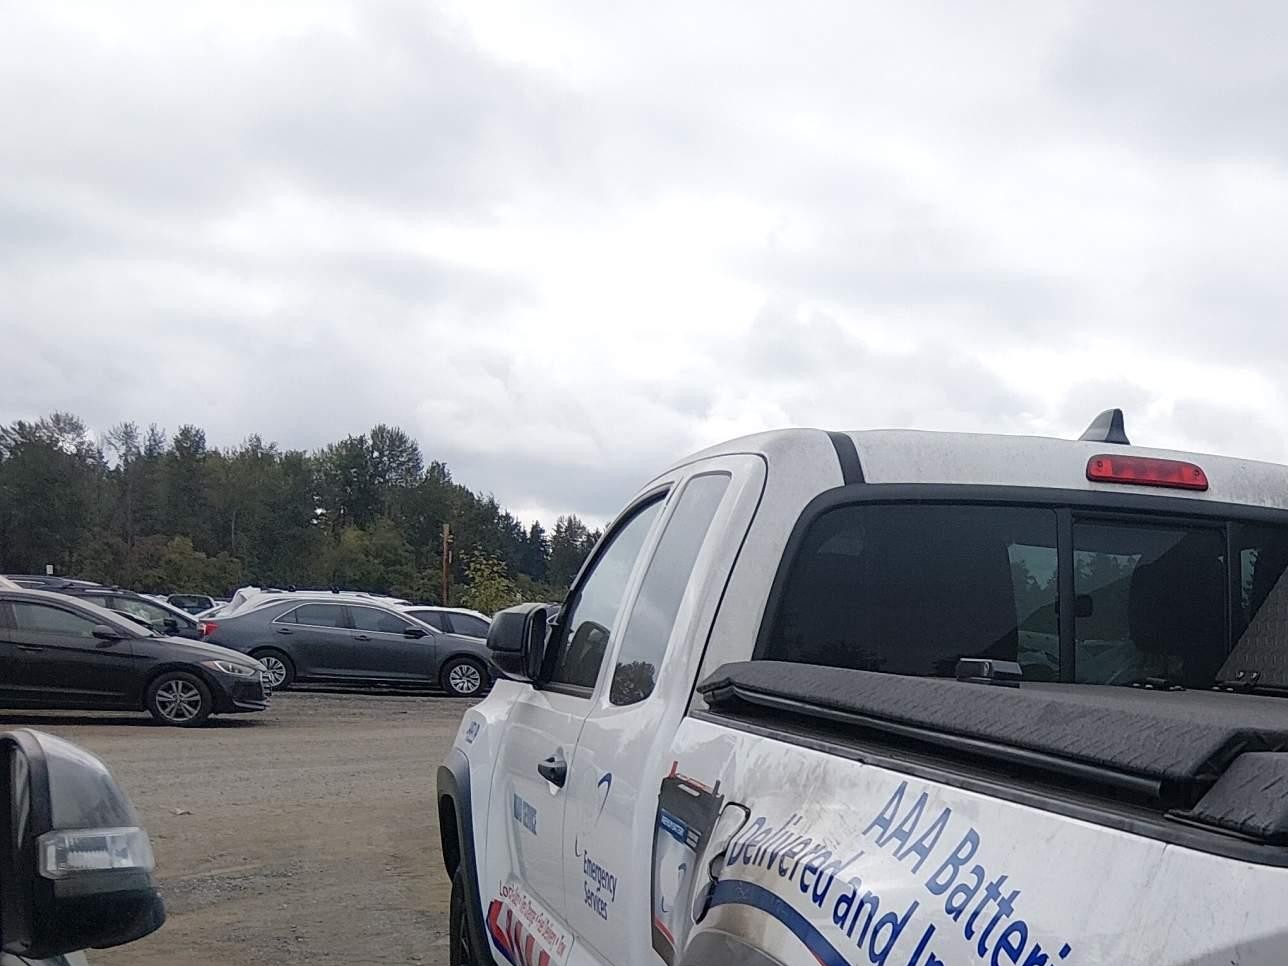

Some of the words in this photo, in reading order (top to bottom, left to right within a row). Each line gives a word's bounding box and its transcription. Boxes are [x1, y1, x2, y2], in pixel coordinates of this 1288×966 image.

[726, 812, 867, 909] Delivered
[862, 780, 952, 875] AAA
[582, 850, 618, 903] Emergency
[584, 882, 608, 921] Services
